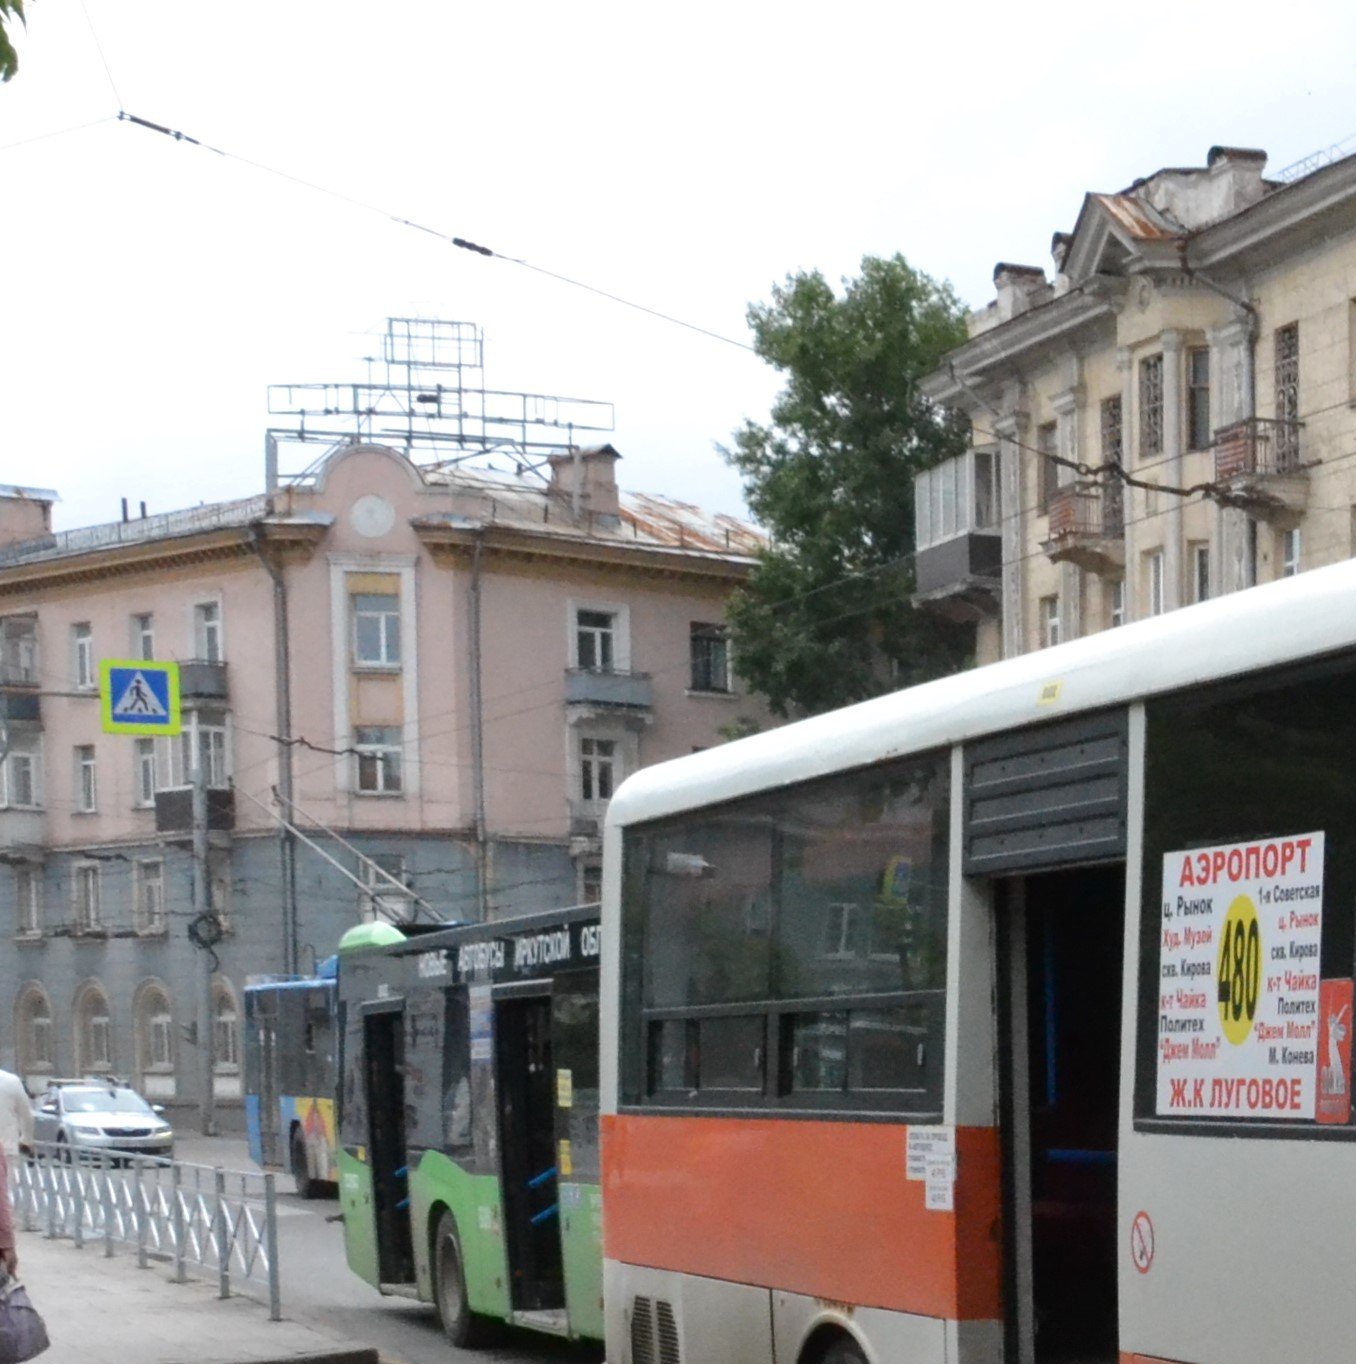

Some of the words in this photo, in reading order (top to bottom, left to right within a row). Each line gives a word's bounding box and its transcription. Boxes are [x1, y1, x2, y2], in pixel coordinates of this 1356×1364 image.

[1179, 839, 1312, 887] АЭРОПОРТ
[1273, 884, 1320, 900] Советская
[1177, 895, 1213, 916] Рынок
[1289, 911, 1319, 929] Рынок
[1184, 925, 1213, 949] Музей
[1289, 941, 1318, 963] Кирова
[1180, 958, 1211, 980] Кирова
[1218, 918, 1259, 1022] 480
[1284, 969, 1317, 992] Чайка
[1176, 988, 1207, 1009] Чайка
[1277, 997, 1316, 1015] Политех
[1160, 1015, 1205, 1033] Политех
[1281, 1047, 1314, 1065] Конева
[1169, 1078, 1205, 1108] Ж.К
[1209, 1078, 1302, 1110] ЛУГОВОЕ
